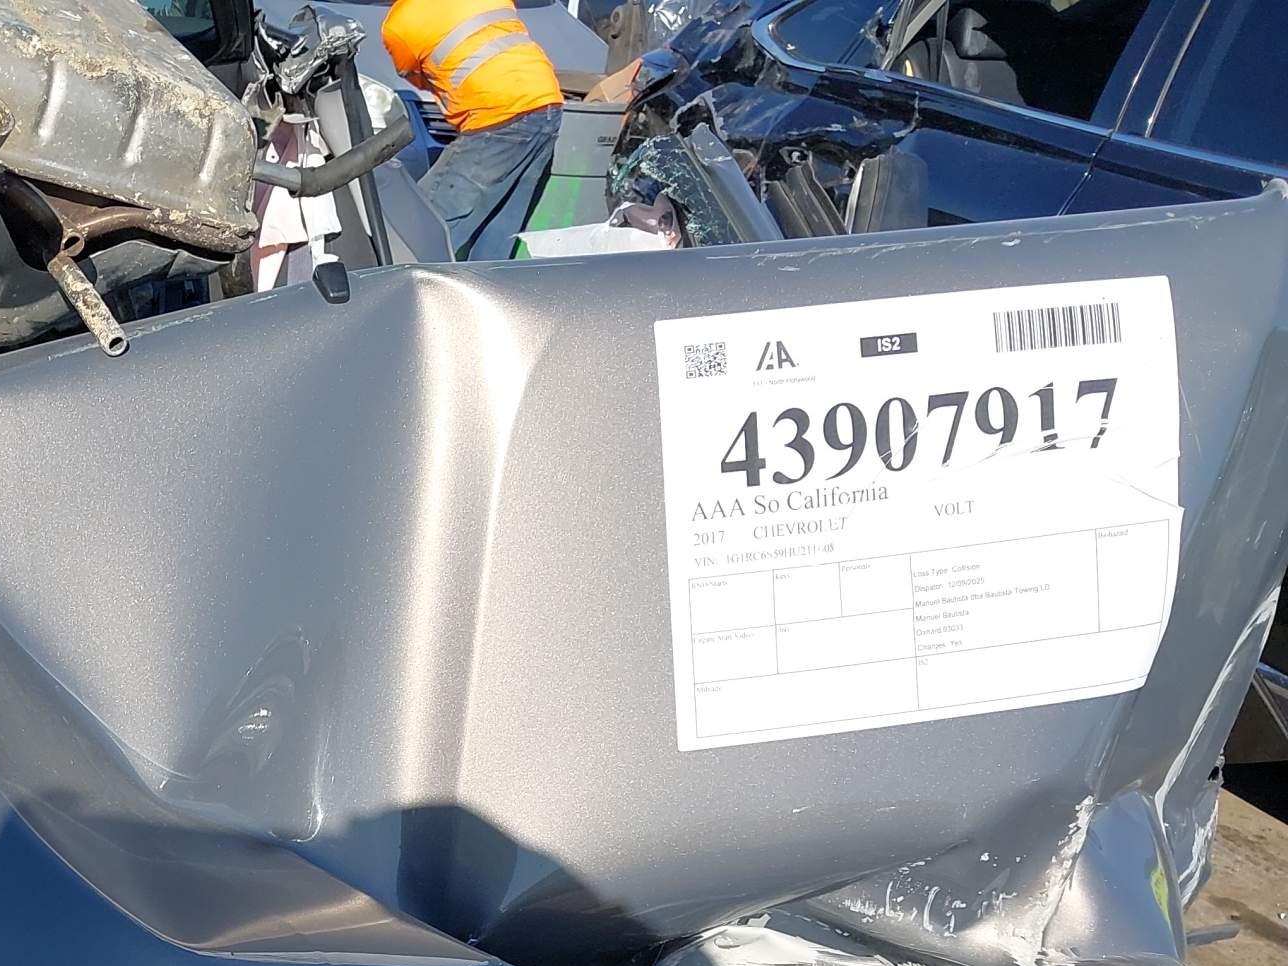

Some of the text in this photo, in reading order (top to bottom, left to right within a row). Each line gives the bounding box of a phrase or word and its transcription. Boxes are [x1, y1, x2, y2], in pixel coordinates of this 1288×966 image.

[877, 337, 901, 352] IS2
[721, 377, 1118, 487] 43907917
[692, 486, 889, 521] AAA So California
[693, 530, 725, 546] 2017
[934, 500, 975, 517] VOLT
[1015, 585, 1038, 595] Towing
